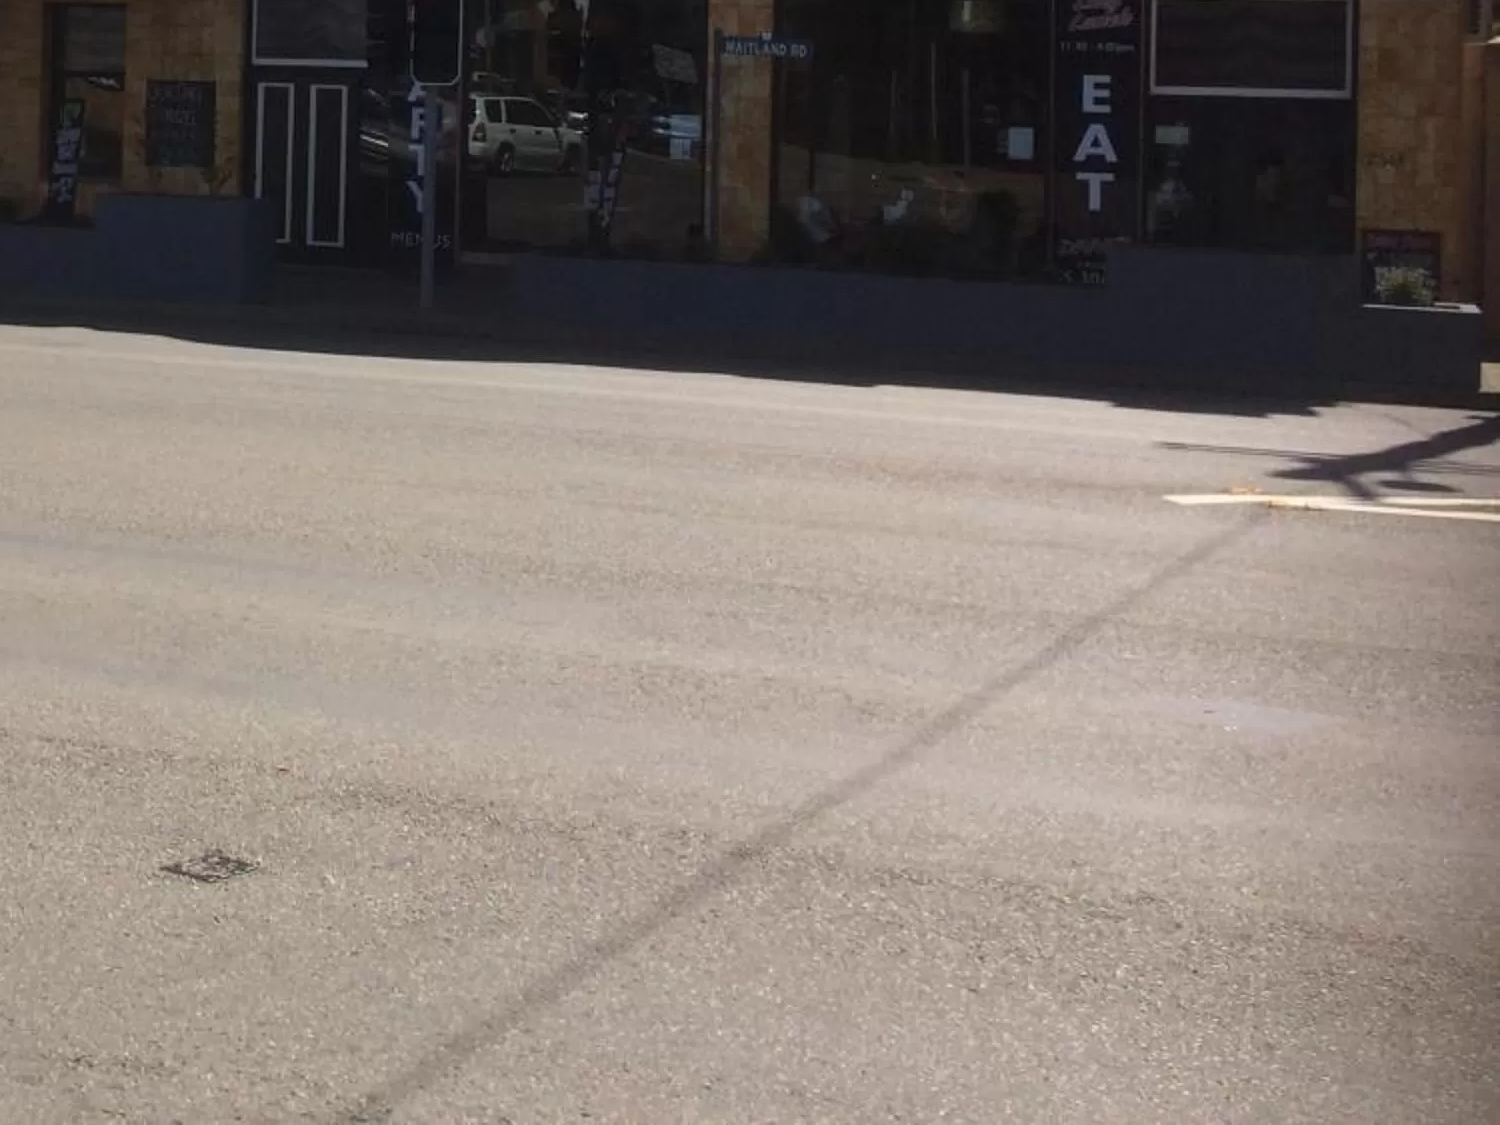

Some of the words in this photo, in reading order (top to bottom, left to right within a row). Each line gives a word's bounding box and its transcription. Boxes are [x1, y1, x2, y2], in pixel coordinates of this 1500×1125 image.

[725, 39, 787, 57] MAITLAND
[790, 42, 808, 59] RD
[1072, 74, 1118, 212] EAT
